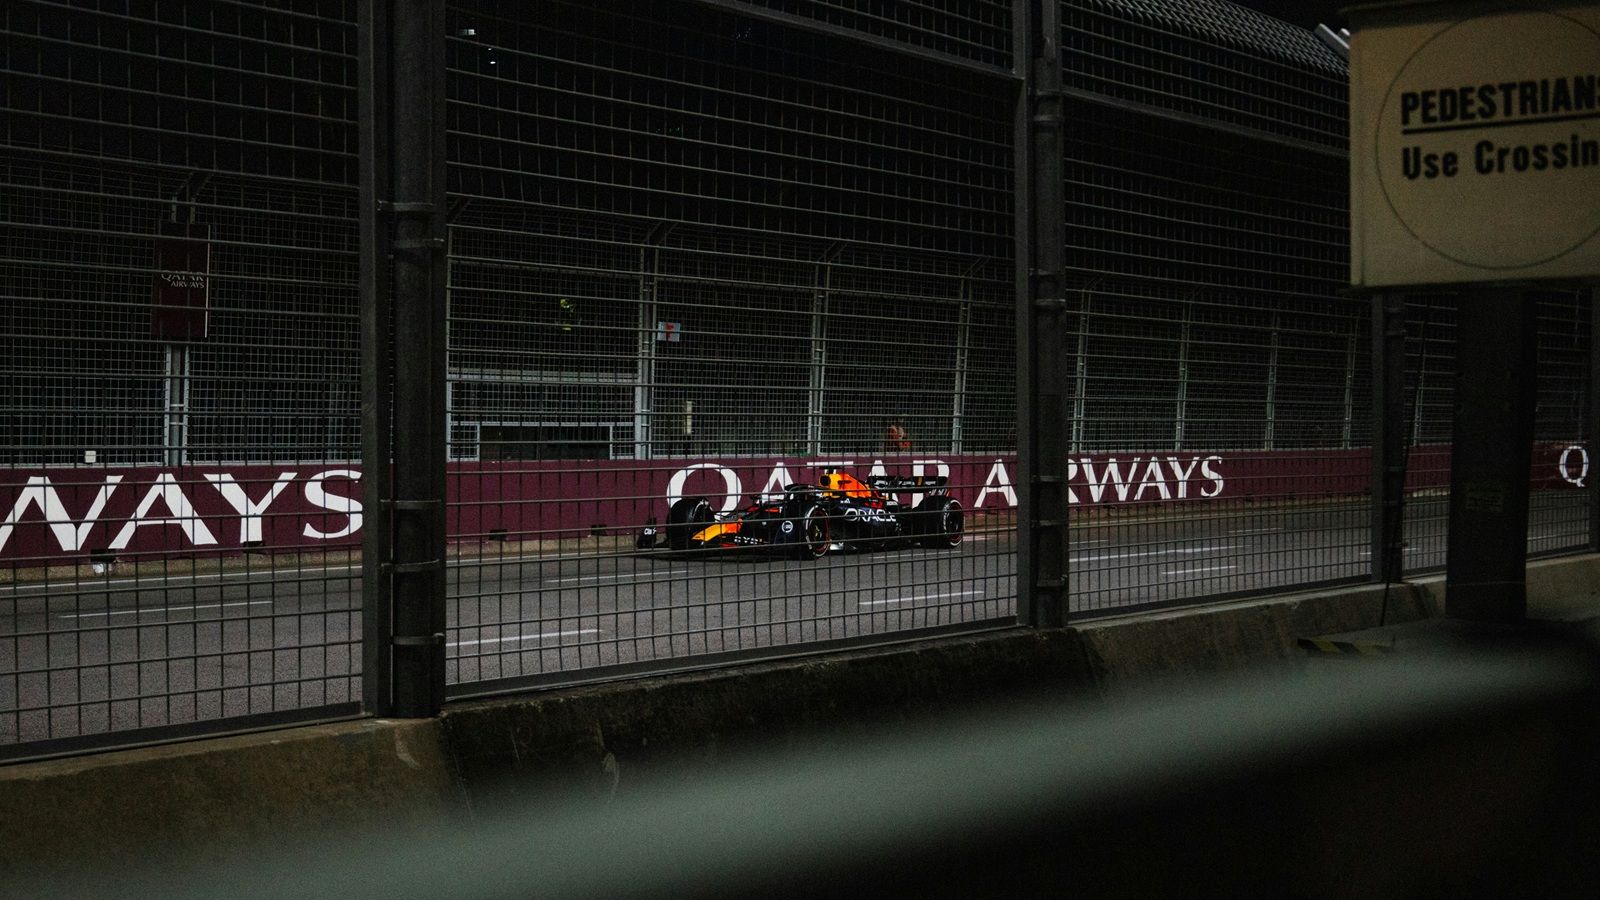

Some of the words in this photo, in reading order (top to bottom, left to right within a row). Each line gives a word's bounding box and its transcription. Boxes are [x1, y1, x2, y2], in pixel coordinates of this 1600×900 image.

[1401, 75, 1600, 125] PEDESTRIAN
[1402, 146, 1458, 180] Use
[1475, 134, 1599, 175] Crossin
[171, 280, 205, 289] AIRWAYS
[974, 455, 1224, 508] AWAYS
